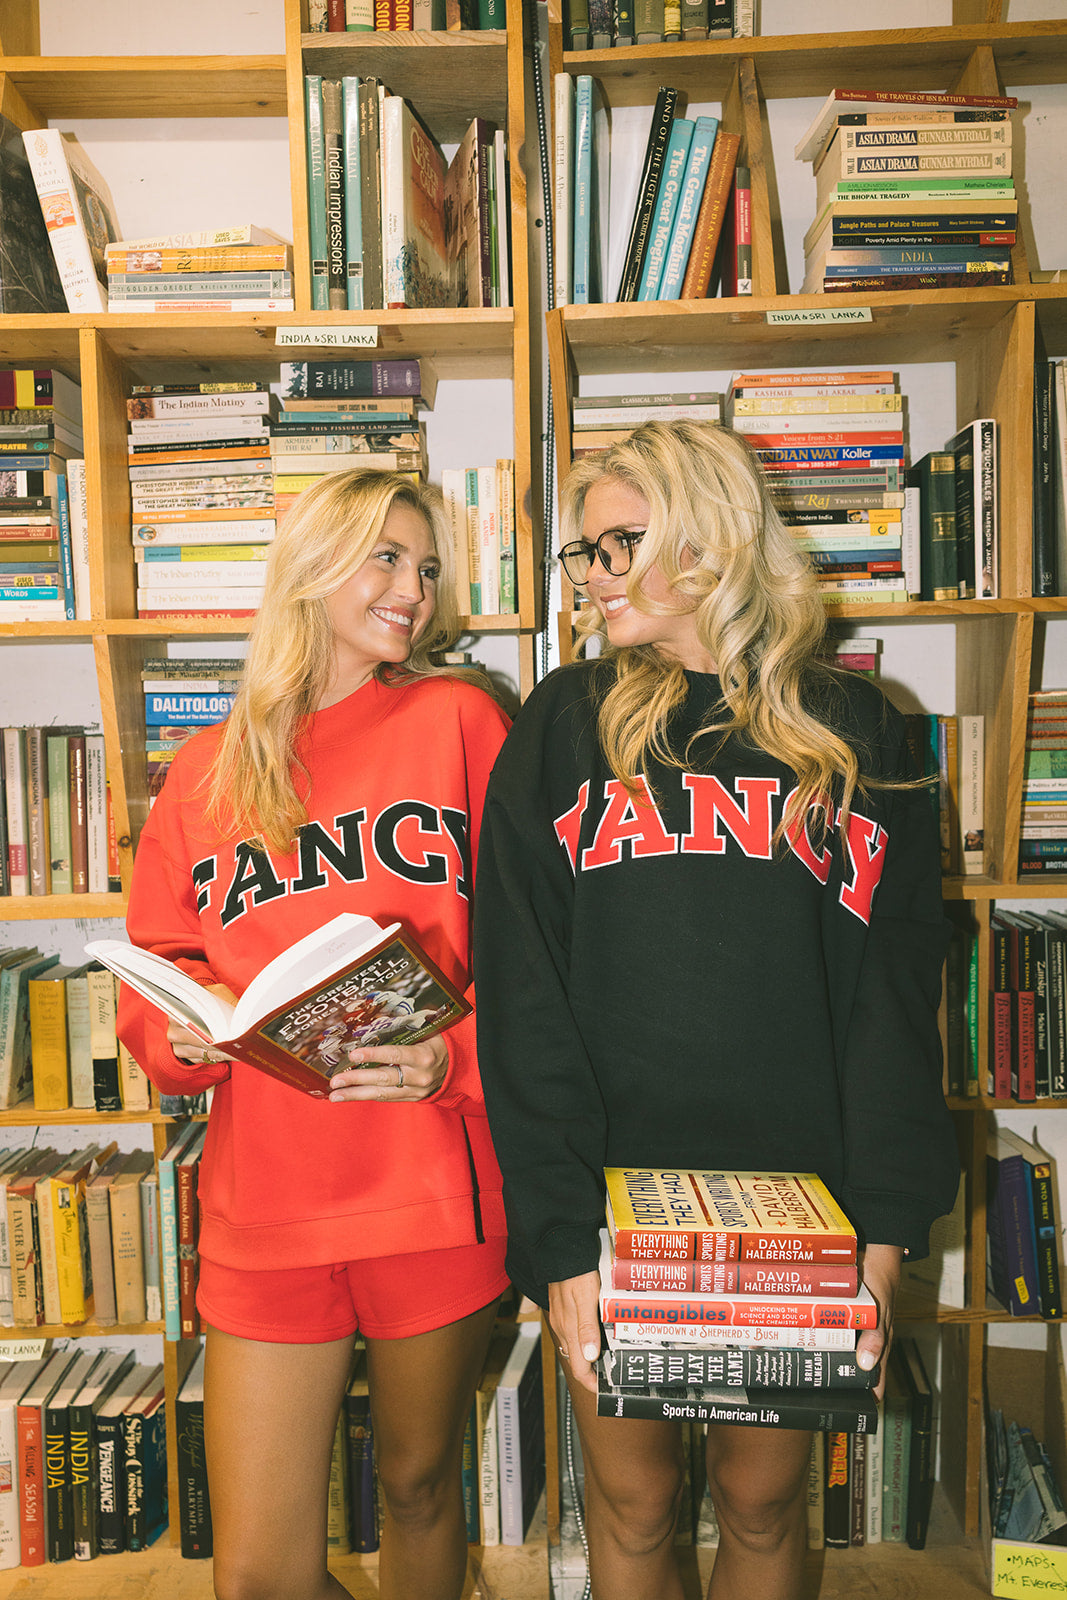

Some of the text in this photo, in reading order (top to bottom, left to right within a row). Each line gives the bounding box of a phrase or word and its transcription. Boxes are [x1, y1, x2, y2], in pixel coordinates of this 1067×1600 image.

[661, 90, 676, 124] LAND
[658, 127, 668, 142] OF
[858, 129, 990, 146] ASIAN DRAMA GUNNAR MYRDAL
[652, 146, 665, 169] THE
[860, 155, 990, 172] ASIAN DRAMA GUNNAR MYRDAL
[644, 172, 659, 207] TIGER
[328, 147, 345, 275] Indian impressions
[646, 149, 686, 289] The Great Moghuls
[666, 145, 708, 285] The Great Moghuls
[840, 222, 859, 230] Jungle
[912, 220, 940, 228] Treasures
[901, 252, 934, 262] INDIA
[281, 334, 311, 344] INDIA
[320, 334, 337, 344] SRI
[342, 335, 376, 344] LANKA
[316, 372, 324, 388] RAJ
[158, 398, 246, 410] The Indian Mutiny
[984, 432, 992, 502] UNTOUCHABLES
[984, 511, 992, 546] NARENDRA
[3, 590, 28, 598] WORDS
[153, 696, 236, 712] DALITOLOGY
[1022, 862, 1042, 870] BLOOD
[278, 958, 404, 1036] FOOTBALL
[284, 959, 382, 1020] THE GREATEST
[284, 960, 410, 1042] STORIES EVER TOLD
[98, 996, 110, 1025] India
[1022, 997, 1032, 1070] BARBARIANS
[181, 1172, 188, 1184] AN
[624, 1172, 670, 1226] EVERYTHING
[660, 1172, 698, 1226] THEY HAD
[702, 1174, 748, 1228] SPORTS WRITING
[752, 1183, 788, 1218] DAVID
[768, 1176, 817, 1230] HALBERSTAM
[182, 1214, 190, 1239] AFFAIR
[162, 1186, 178, 1312] The Great Moghuls
[631, 1233, 688, 1249] EVERYTHING
[631, 1248, 688, 1259] THEY HAD
[701, 1233, 714, 1261] SPORTS
[715, 1232, 728, 1262] WRITING
[758, 1238, 802, 1250] DAVID
[13, 1210, 27, 1300] LANCER AT LARGE
[746, 1250, 814, 1260] HALBERSTAM
[630, 1264, 687, 1280] EVERYTHING
[700, 1264, 712, 1292] SPORTS
[714, 1264, 726, 1294] WRITING
[756, 1270, 800, 1283] DAVID
[630, 1280, 686, 1290] THEY HAD
[744, 1282, 812, 1294] HALBERSTAM
[614, 1302, 726, 1323] intangibles
[820, 1310, 846, 1318] JOAN
[820, 1318, 845, 1326] RYAN
[637, 1324, 779, 1341] SHOWDOWN at SHEPHERD'S BUSH
[14, 1344, 42, 1354] LANKA
[628, 1356, 644, 1381] IT'S
[648, 1352, 664, 1384] HOW
[668, 1356, 684, 1382] YOU
[688, 1353, 704, 1384] PLAY
[708, 1356, 724, 1382] THE
[727, 1351, 744, 1386] GAME
[804, 1360, 813, 1382] BRIAN
[814, 1352, 822, 1386] KILMEADE
[849, 1364, 856, 1376] HC
[504, 1397, 512, 1410] THE
[615, 1398, 624, 1416] Davies
[662, 1402, 780, 1423] Sports in American Life
[504, 1416, 512, 1465] BILLIONAIRE
[70, 1430, 88, 1486] INDIA
[125, 1418, 142, 1516] Sepoy Cossack
[482, 1427, 493, 1506] Women of the Raj
[98, 1440, 114, 1513] VENGEANCE
[188, 1478, 197, 1536] DALRYMPLE
[1012, 1555, 1050, 1569] MAPS
[1022, 1576, 1067, 1592] Everest
